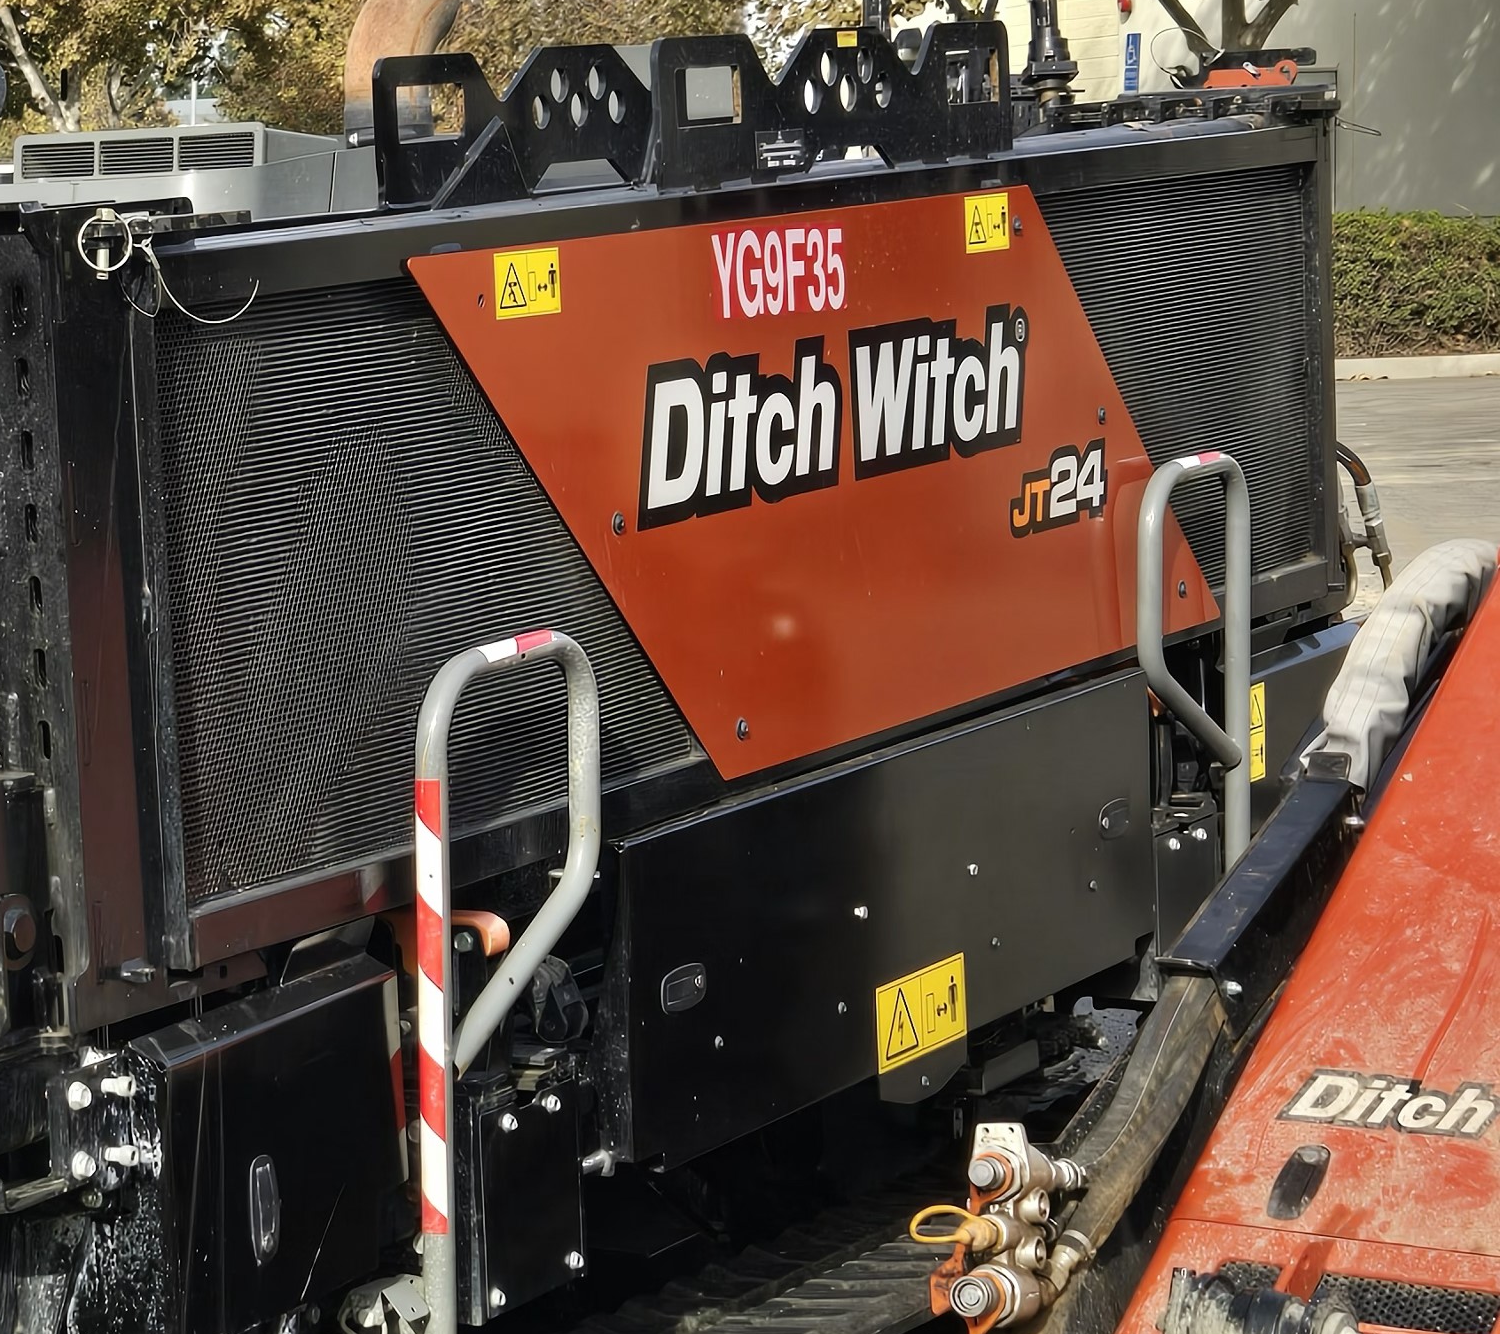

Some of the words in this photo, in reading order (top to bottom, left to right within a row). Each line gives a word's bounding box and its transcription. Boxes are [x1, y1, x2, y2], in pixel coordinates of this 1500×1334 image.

[711, 228, 845, 318] YG9F35
[647, 355, 836, 509] Ditch
[1013, 449, 1104, 528] JT24
[1289, 1074, 1495, 1133] Ditch
